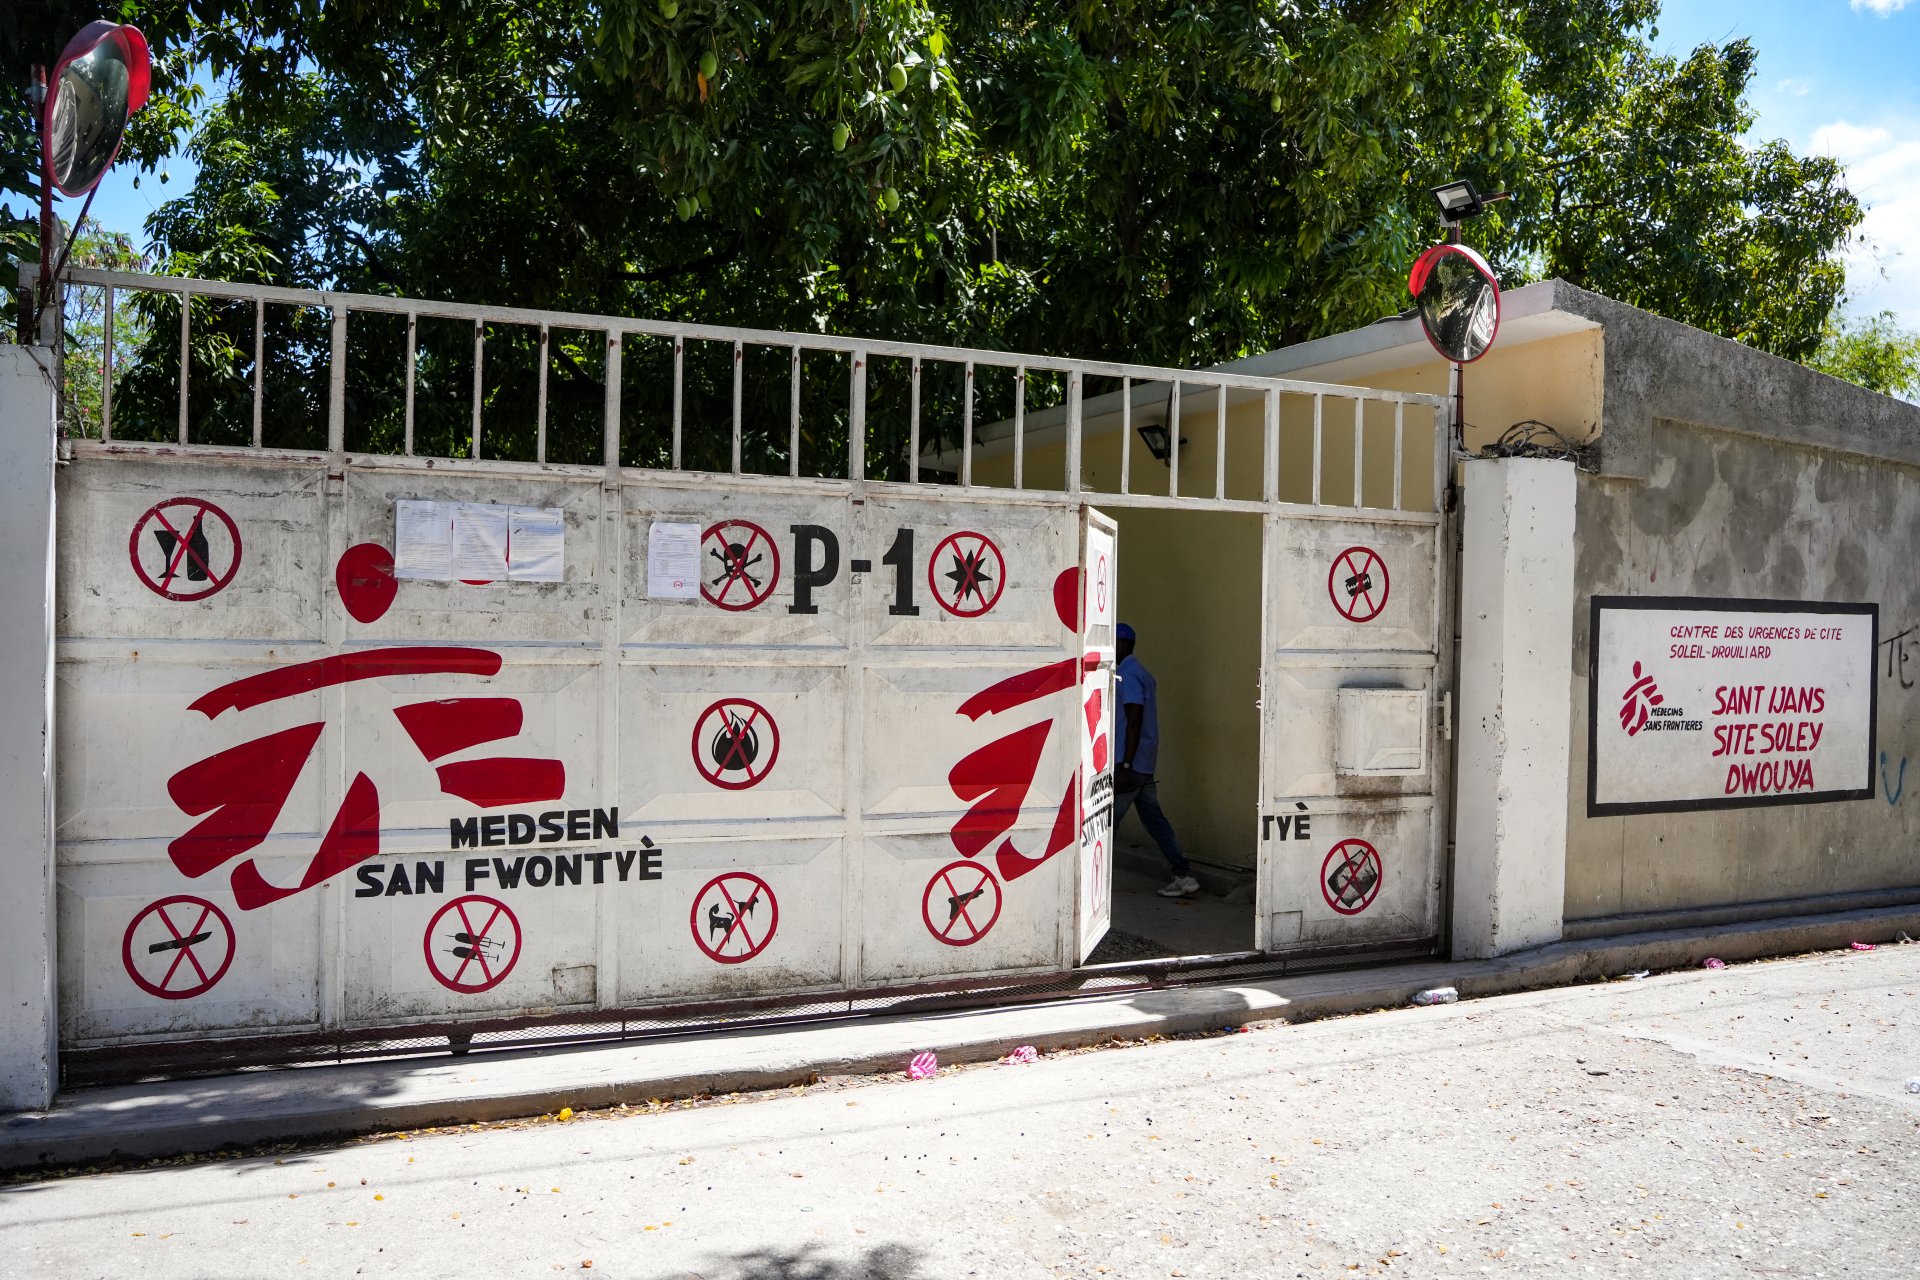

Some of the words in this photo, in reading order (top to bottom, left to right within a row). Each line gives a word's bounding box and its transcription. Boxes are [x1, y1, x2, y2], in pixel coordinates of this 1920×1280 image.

[789, 524, 920, 616] P-1
[1670, 625, 1718, 639] CENTRE
[1724, 626, 1743, 639] DES
[1748, 626, 1800, 640] URGENCES
[1804, 628, 1816, 640] DE
[1820, 628, 1842, 641] CITE
[1712, 685, 1765, 716] SANT
[1768, 686, 1826, 715] IJANS
[1643, 720, 1662, 732] SANS
[1662, 720, 1703, 731] FRONTIERES
[1712, 723, 1759, 757] SITE
[1759, 722, 1824, 755] SOLEY
[1724, 759, 1815, 795] DWOUYA
[449, 806, 619, 850] MEDSEN
[354, 860, 445, 898] SAN
[464, 834, 663, 892] FWONTYÈ
